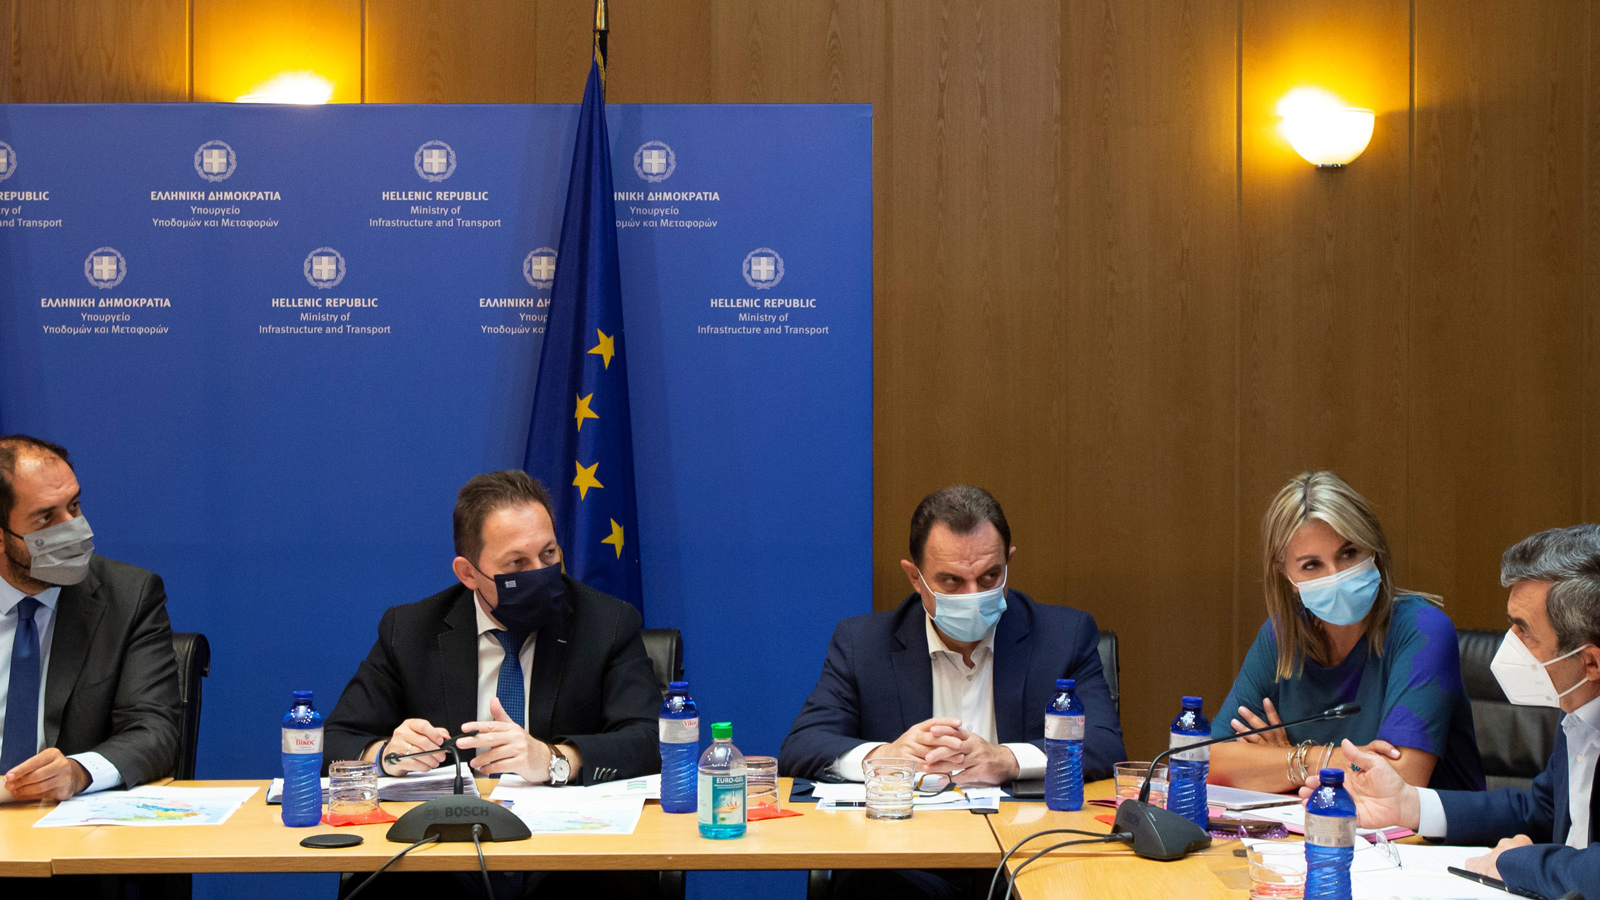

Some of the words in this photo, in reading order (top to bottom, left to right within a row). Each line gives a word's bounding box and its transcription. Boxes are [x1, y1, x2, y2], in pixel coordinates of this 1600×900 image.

[150, 191, 205, 201] ΕΛΛΗΝΙΚΗ
[207, 191, 281, 201] ΔΗΜΟΚΡΑΤΙΑ
[382, 191, 432, 201] HELLENIC
[435, 191, 489, 201] REPUBLIC
[647, 191, 720, 201] ΔΗΜΟΚΡΑΤΙΑ
[12, 205, 22, 215] of
[191, 205, 240, 217] Υπουργείο
[410, 205, 449, 217] Ministry
[451, 205, 461, 215] of
[630, 206, 679, 217] Υπουργείο
[17, 218, 62, 229] Transport
[152, 217, 201, 229] Υποδομών
[204, 219, 219, 227] και
[221, 217, 279, 229] Μεταφορών
[369, 217, 433, 228] Infrastructure
[436, 218, 453, 228] and
[456, 217, 501, 229] Transport
[643, 220, 658, 228] και
[660, 218, 718, 229] Μεταφορών
[41, 298, 95, 308] ΕΛΛΗΝΙΚΗ
[98, 298, 171, 308] ΔΗΜΟΚΡΑΤΙΑ
[272, 298, 322, 308] HELLENIC
[325, 298, 379, 308] REPUBLIC
[480, 298, 534, 308] ΕΛΛΗΝΙΚΗ
[711, 298, 761, 308] HELLENIC
[764, 298, 817, 308] REPUBLIC
[81, 312, 130, 323] Υπουργείο
[300, 312, 338, 323] Ministry
[341, 312, 351, 322] of
[738, 312, 777, 323] Ministry
[779, 312, 789, 322] of
[43, 324, 92, 335] Υποδομών
[95, 326, 109, 334] και
[111, 324, 169, 335] Μεταφορών
[259, 324, 323, 334] Infrastructure
[326, 324, 343, 334] and
[346, 324, 391, 335] Transport
[481, 324, 530, 335] Υποδομών
[698, 324, 761, 335] Infrastructure
[764, 325, 781, 335] and
[784, 324, 829, 336] Transport
[716, 776, 744, 784] EURO-GEL
[445, 806, 489, 817] BOSCH
